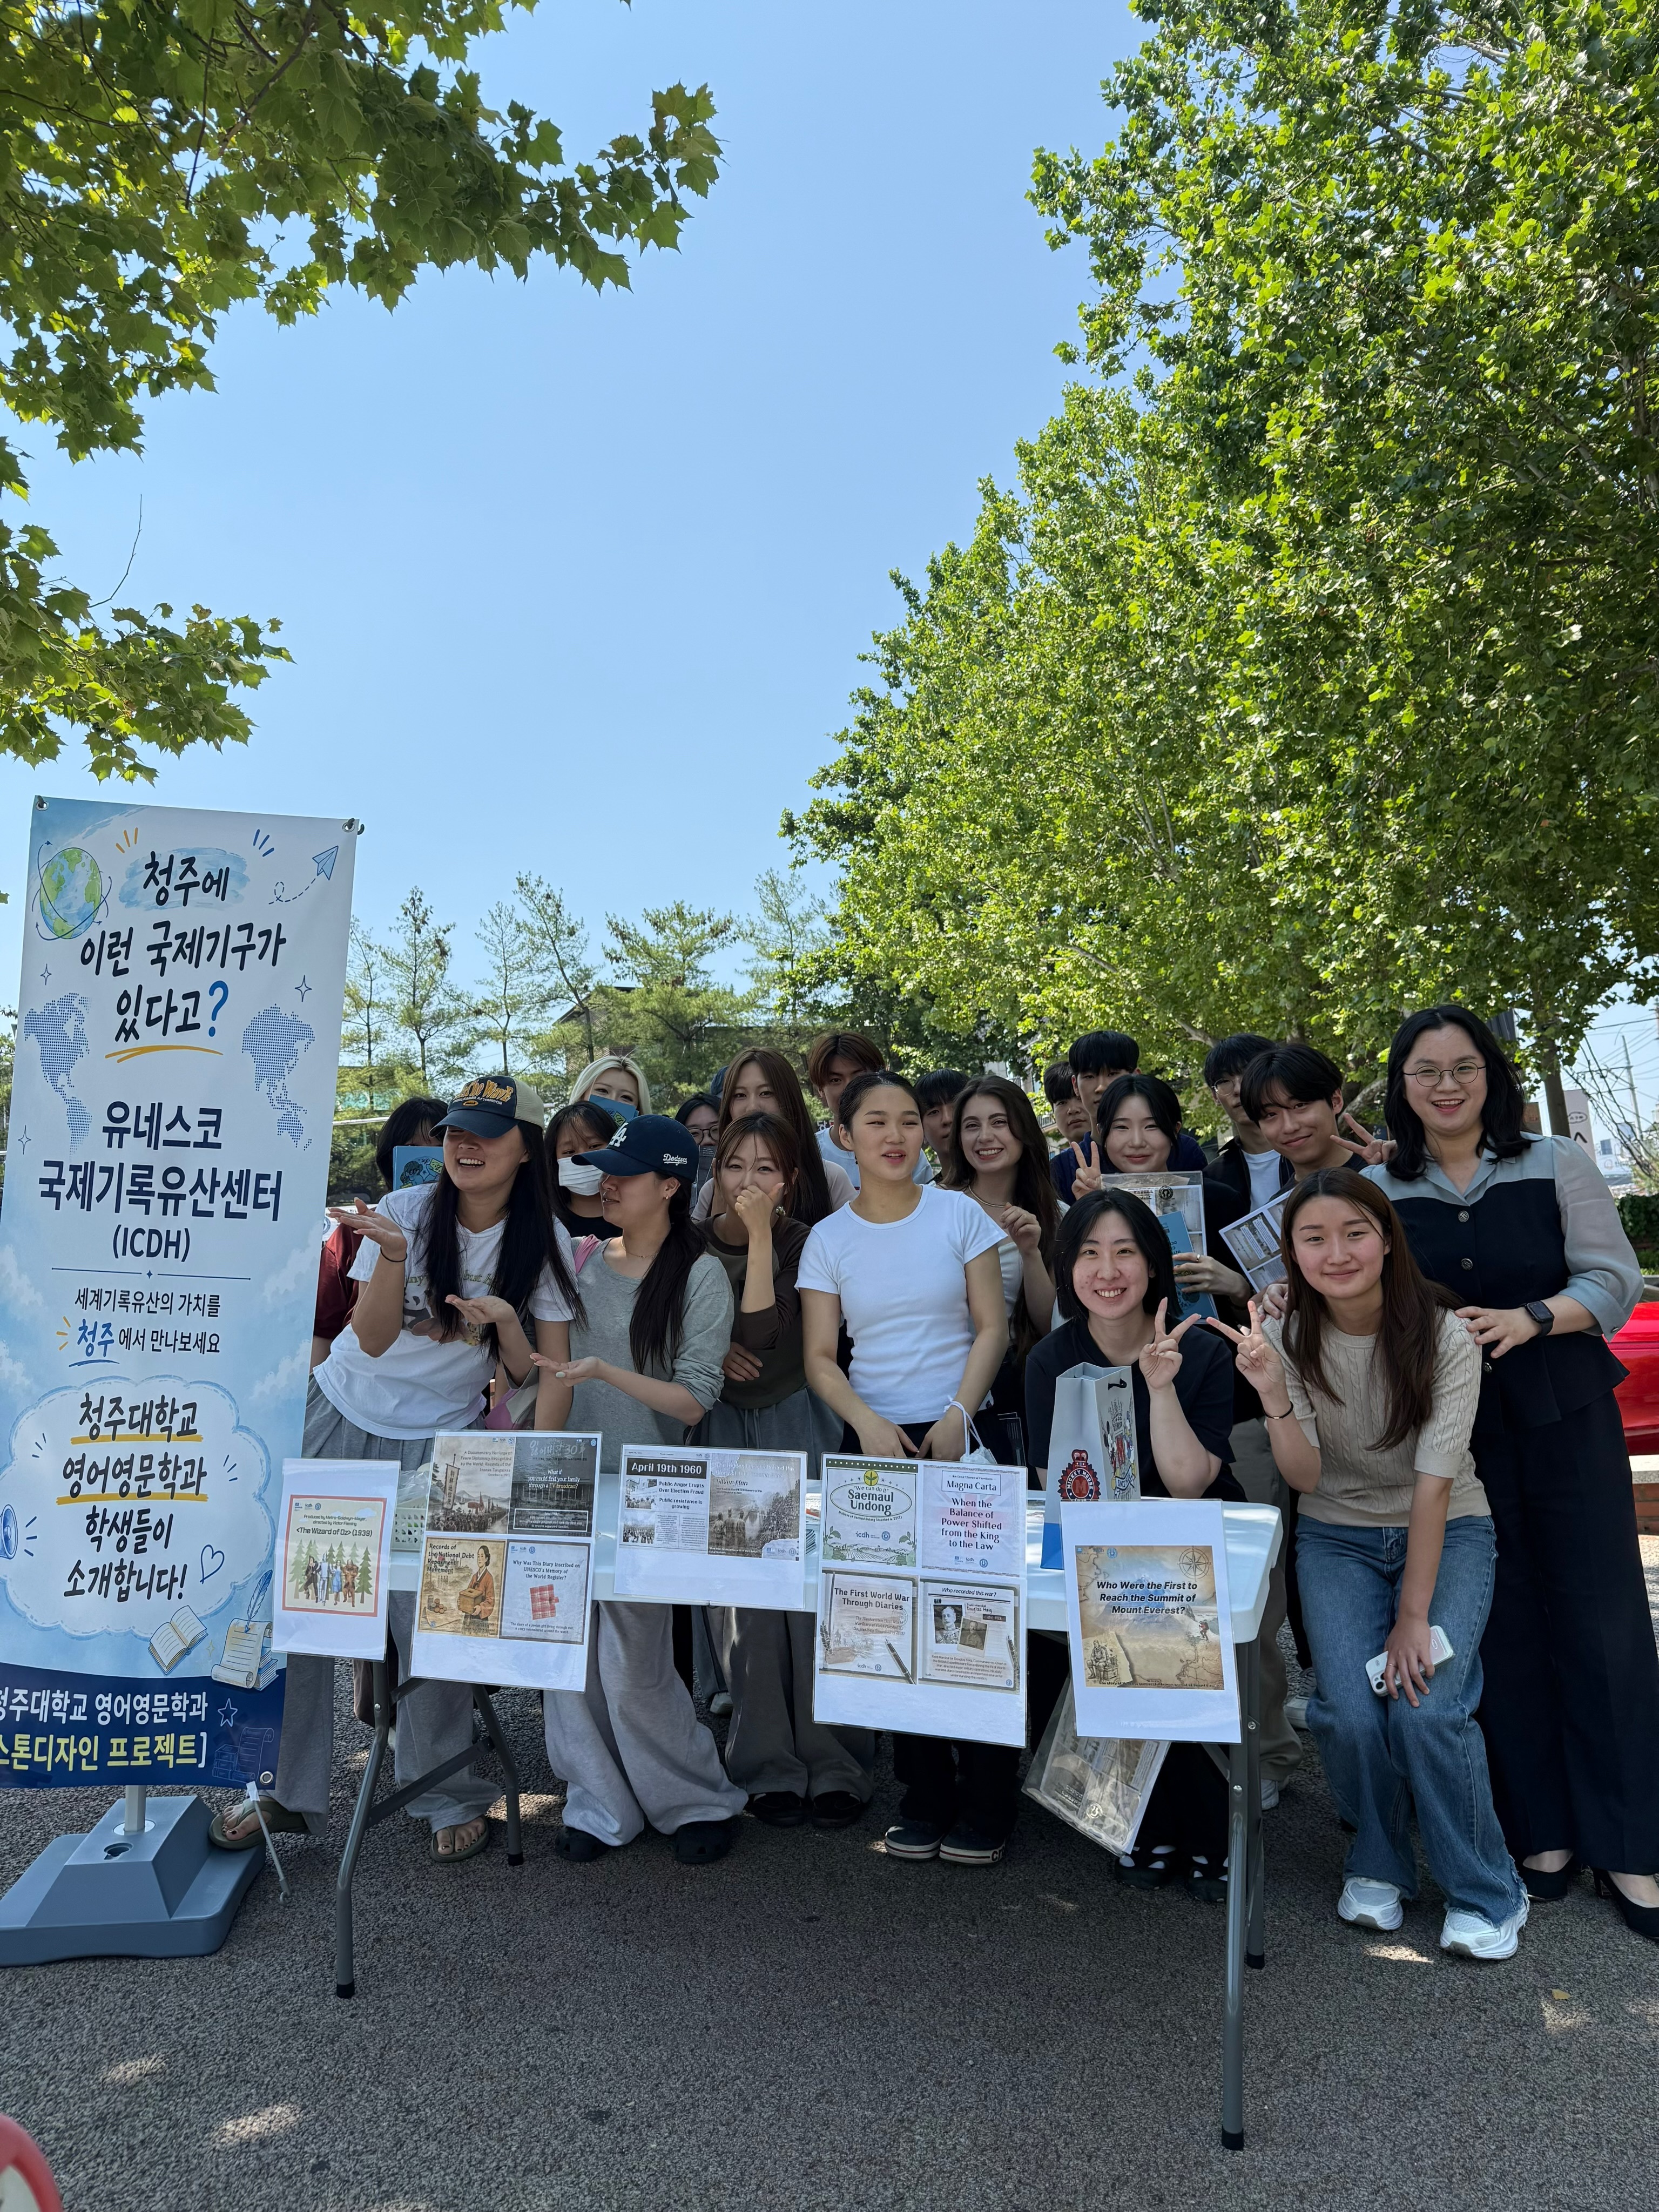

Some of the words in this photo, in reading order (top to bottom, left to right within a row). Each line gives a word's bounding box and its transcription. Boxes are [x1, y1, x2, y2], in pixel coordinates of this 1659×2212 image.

[143, 851, 230, 907] 청주에
[80, 926, 132, 977] 이런
[146, 921, 286, 976] 국제기구가
[114, 980, 229, 1044] 있다고?
[102, 1101, 222, 1151] 유네스코
[38, 1160, 282, 1222] 국제기록유산센터
[113, 1224, 190, 1263] (ICDH)
[75, 1287, 173, 1314] 세계기록유산의
[178, 1293, 220, 1317] 가치를
[77, 1319, 114, 1357] 청주
[119, 1327, 145, 1351] 에서
[151, 1329, 220, 1354] 만나보세요
[80, 1393, 198, 1441] 청주대학교
[63, 1453, 207, 1500] 영어영문학과
[632, 1462, 653, 1472] April
[657, 1464, 677, 1473] 19th
[680, 1465, 702, 1474] 1960
[947, 1480, 973, 1491] Magna
[975, 1482, 996, 1491] Carta
[1067, 1470, 1081, 1489] MICKEY
[1083, 1471, 1093, 1489] MOUSE
[848, 1489, 893, 1502] Saemaul
[952, 1498, 976, 1507] When
[979, 1500, 992, 1508] the
[851, 1500, 891, 1516] Undong
[950, 1508, 983, 1518] Balance
[86, 1506, 173, 1554] 학생들이
[942, 1518, 969, 1527] Power
[972, 1520, 1002, 1530] Shifted
[942, 1528, 961, 1537] from
[965, 1530, 977, 1538] the
[981, 1532, 999, 1543] King
[960, 1540, 973, 1548] the
[976, 1542, 993, 1550] Law
[64, 1560, 187, 1603] 소개합니다!
[1097, 1581, 1117, 1589] Who
[1121, 1581, 1144, 1589] Were
[1147, 1581, 1162, 1589] the
[1164, 1581, 1185, 1590] First
[842, 1598, 873, 1608] Through
[875, 1601, 903, 1610] Diaries
[851, 1589, 868, 1597] First
[871, 1591, 892, 1600] World
[895, 1593, 909, 1601] War
[1100, 1594, 1128, 1602] Reach
[1148, 1594, 1183, 1602] Summit
[1186, 1594, 1196, 1602] of
[1144, 1606, 1185, 1614] Everest?
[96, 1691, 208, 1725] 영어영문학과
[107, 1732, 207, 1768] 프로젝트]
